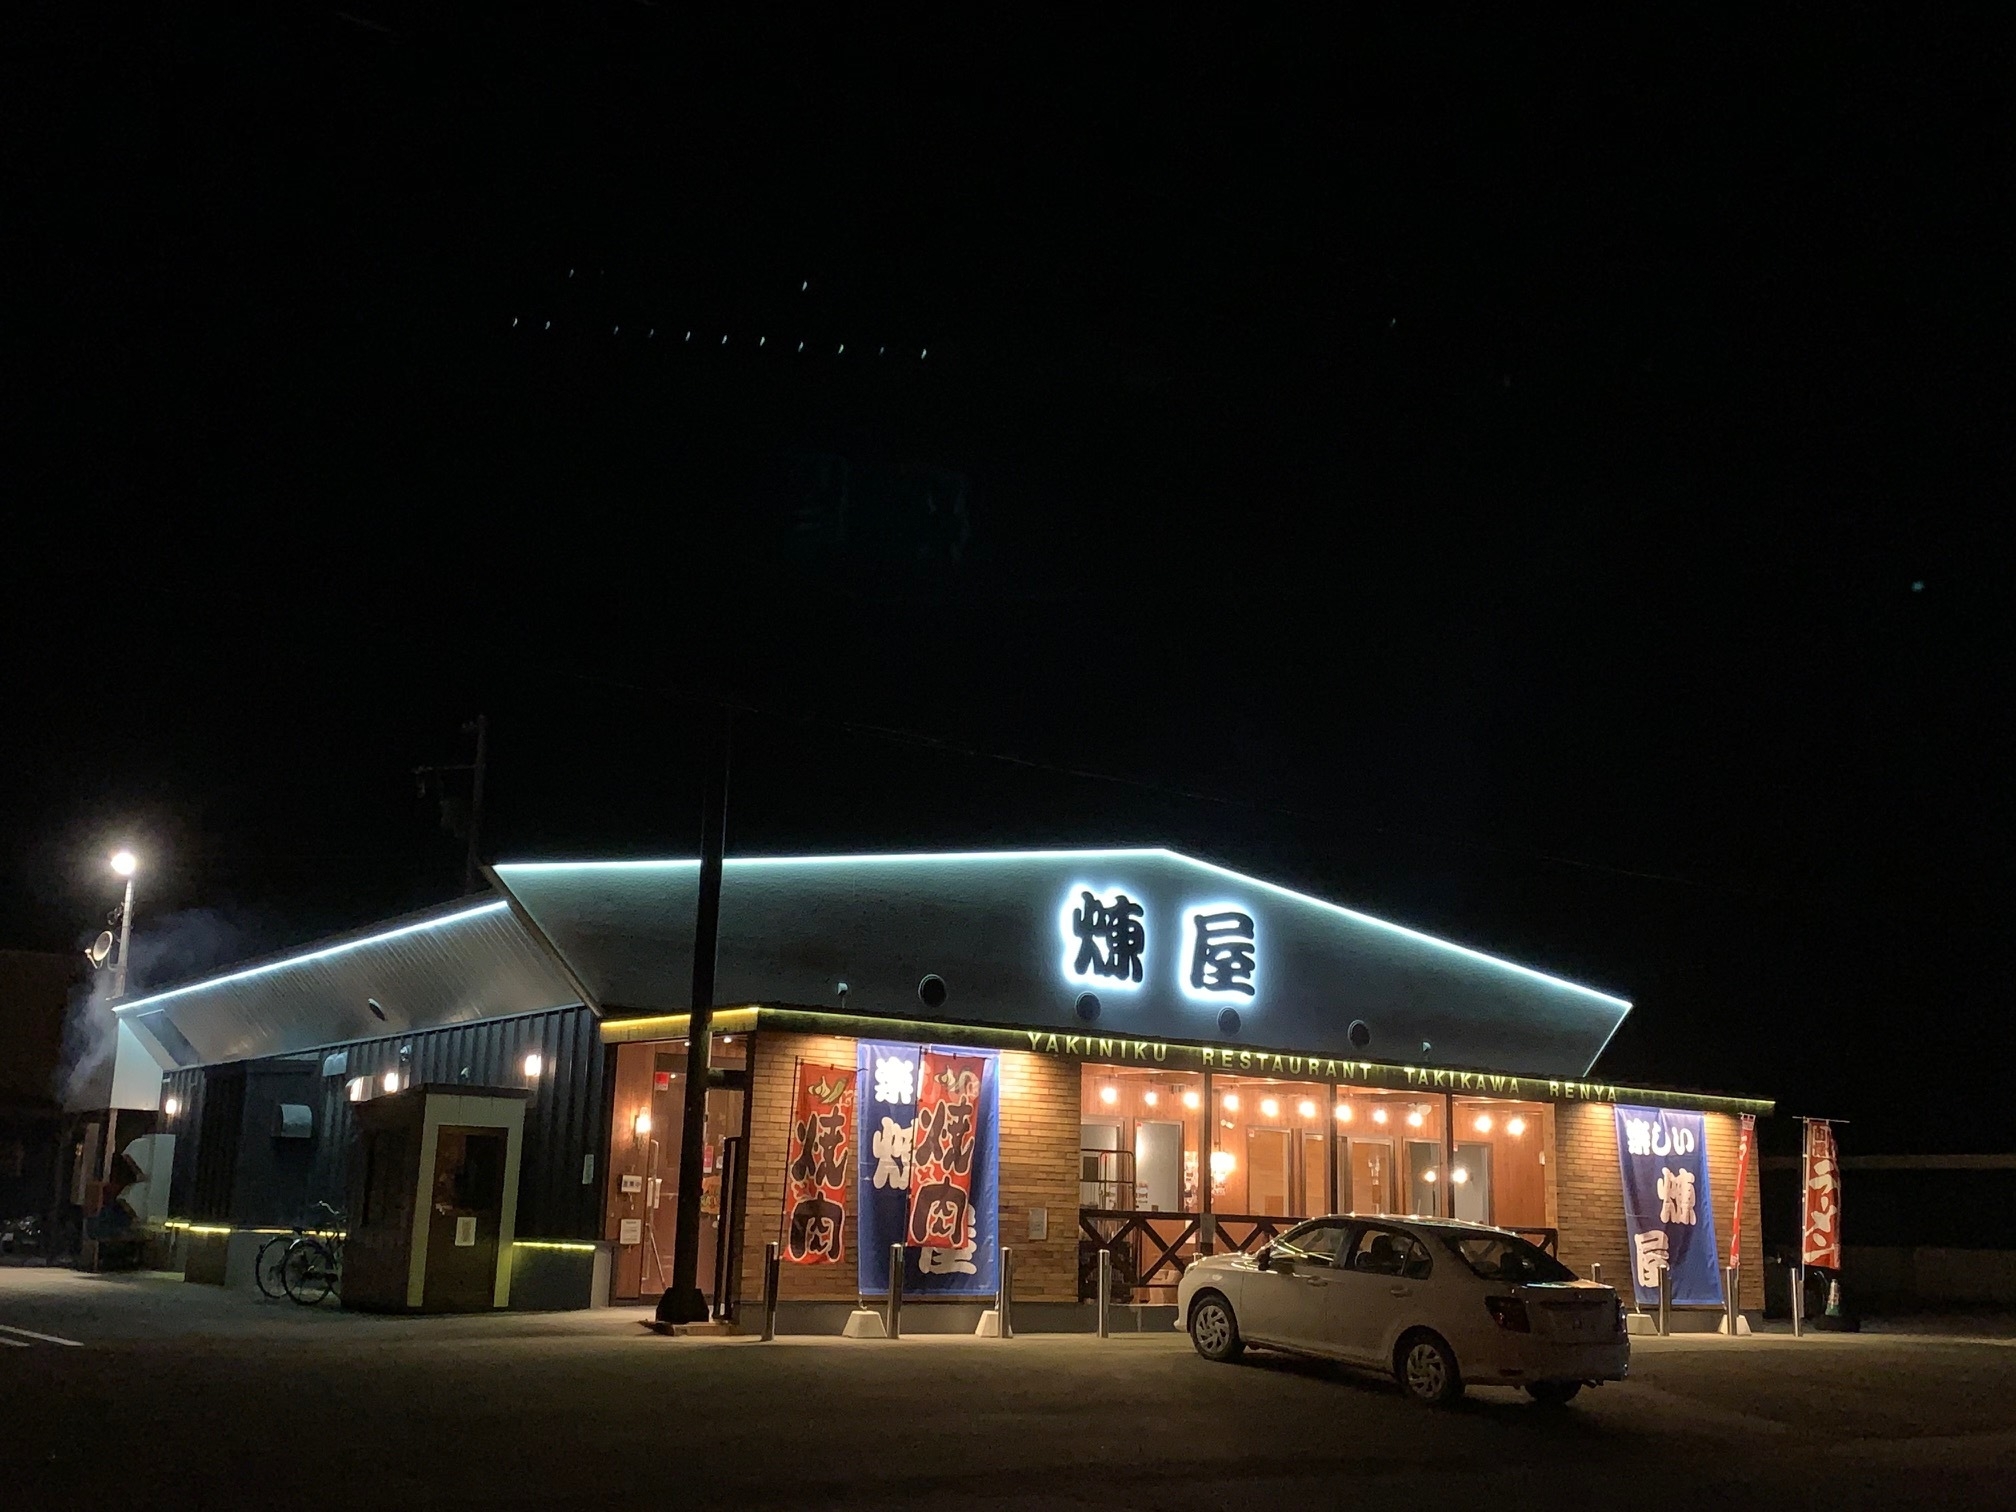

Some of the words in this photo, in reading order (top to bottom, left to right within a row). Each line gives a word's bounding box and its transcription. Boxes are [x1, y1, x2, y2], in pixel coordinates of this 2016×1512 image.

[1073, 891, 1256, 997] 煉屋
[1027, 1032, 1168, 1062] YAKINIKU
[1202, 1047, 1372, 1081] RESTAURANT
[1403, 1067, 1520, 1094] TAKIKAWA
[1549, 1080, 1617, 1101] RENYA
[789, 1105, 849, 1262] 焼肉
[909, 1094, 975, 1245] 焼肉
[1626, 1117, 1695, 1156] 楽しい
